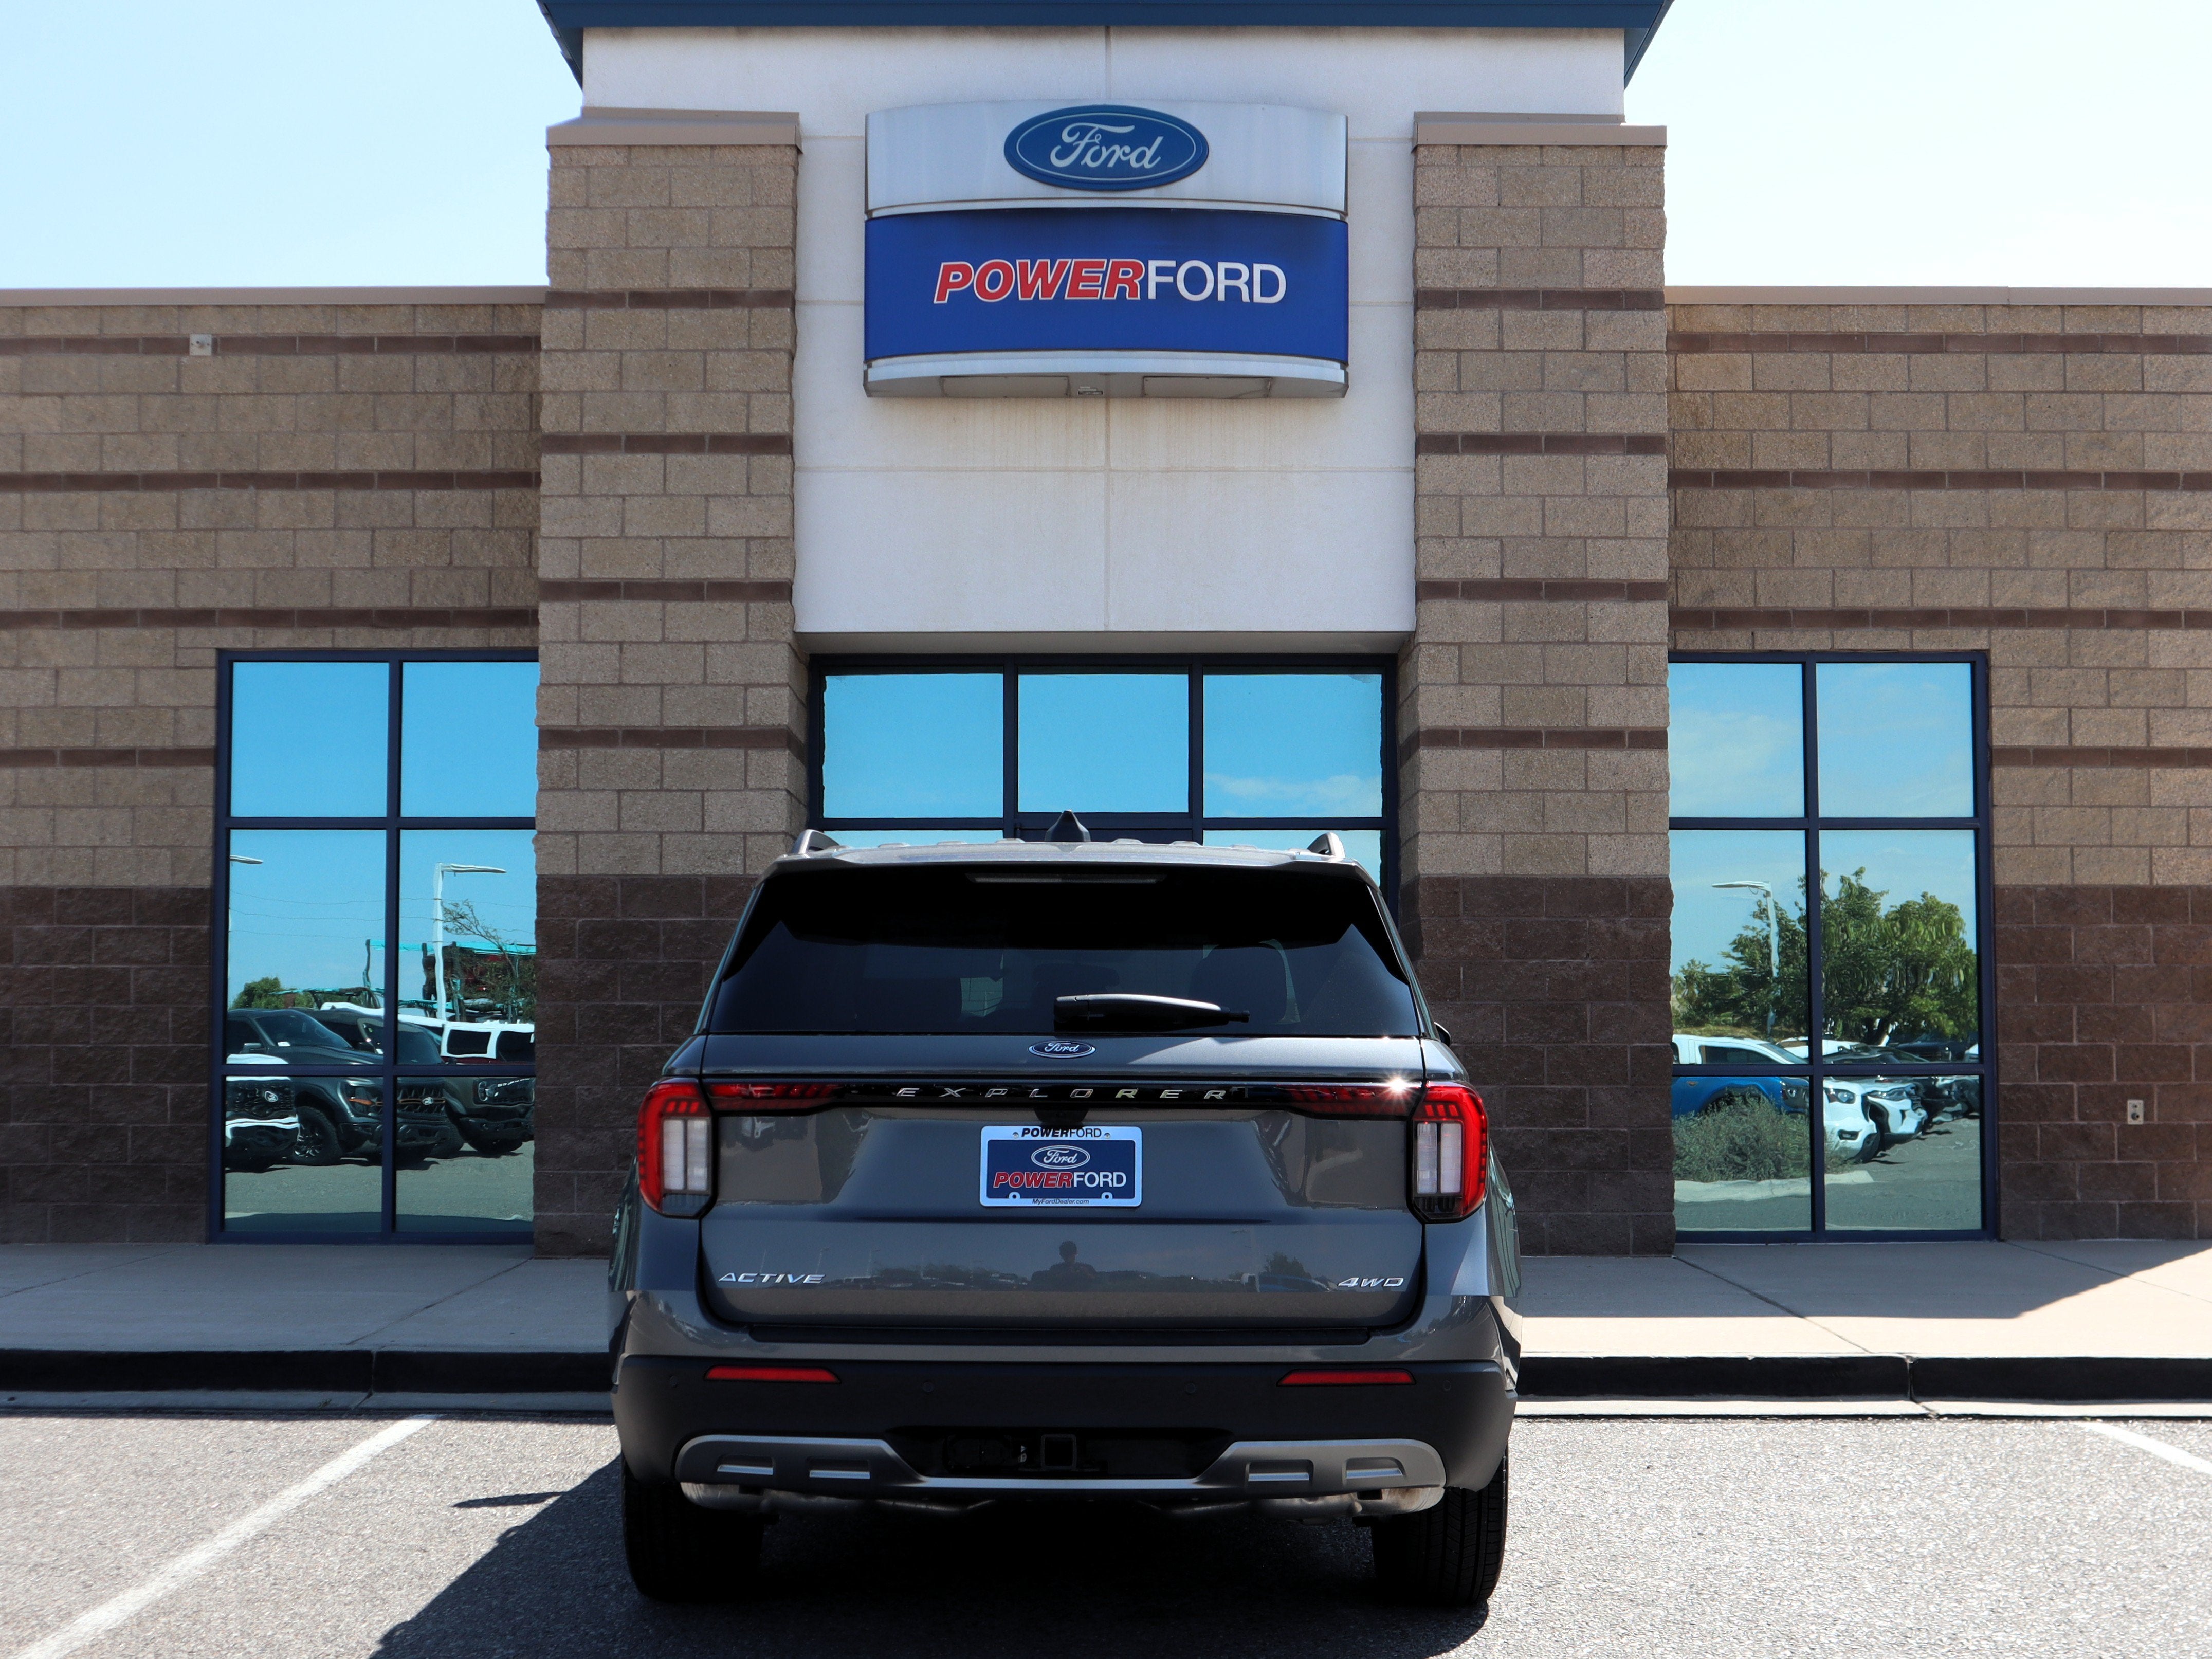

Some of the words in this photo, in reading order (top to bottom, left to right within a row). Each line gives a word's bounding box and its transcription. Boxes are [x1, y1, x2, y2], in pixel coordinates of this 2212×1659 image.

[1050, 122, 1163, 169] Ford
[933, 258, 1287, 304] POWERFORD
[1044, 1042, 1080, 1052] Ford
[895, 1087, 1228, 1099] EXPLORER
[1021, 1127, 1102, 1138] POWERFORD
[1043, 1149, 1077, 1164] Ford
[993, 1171, 1127, 1188] POWERFORD
[718, 1272, 826, 1284] ACTIVE
[1338, 1277, 1404, 1287] 4WD
